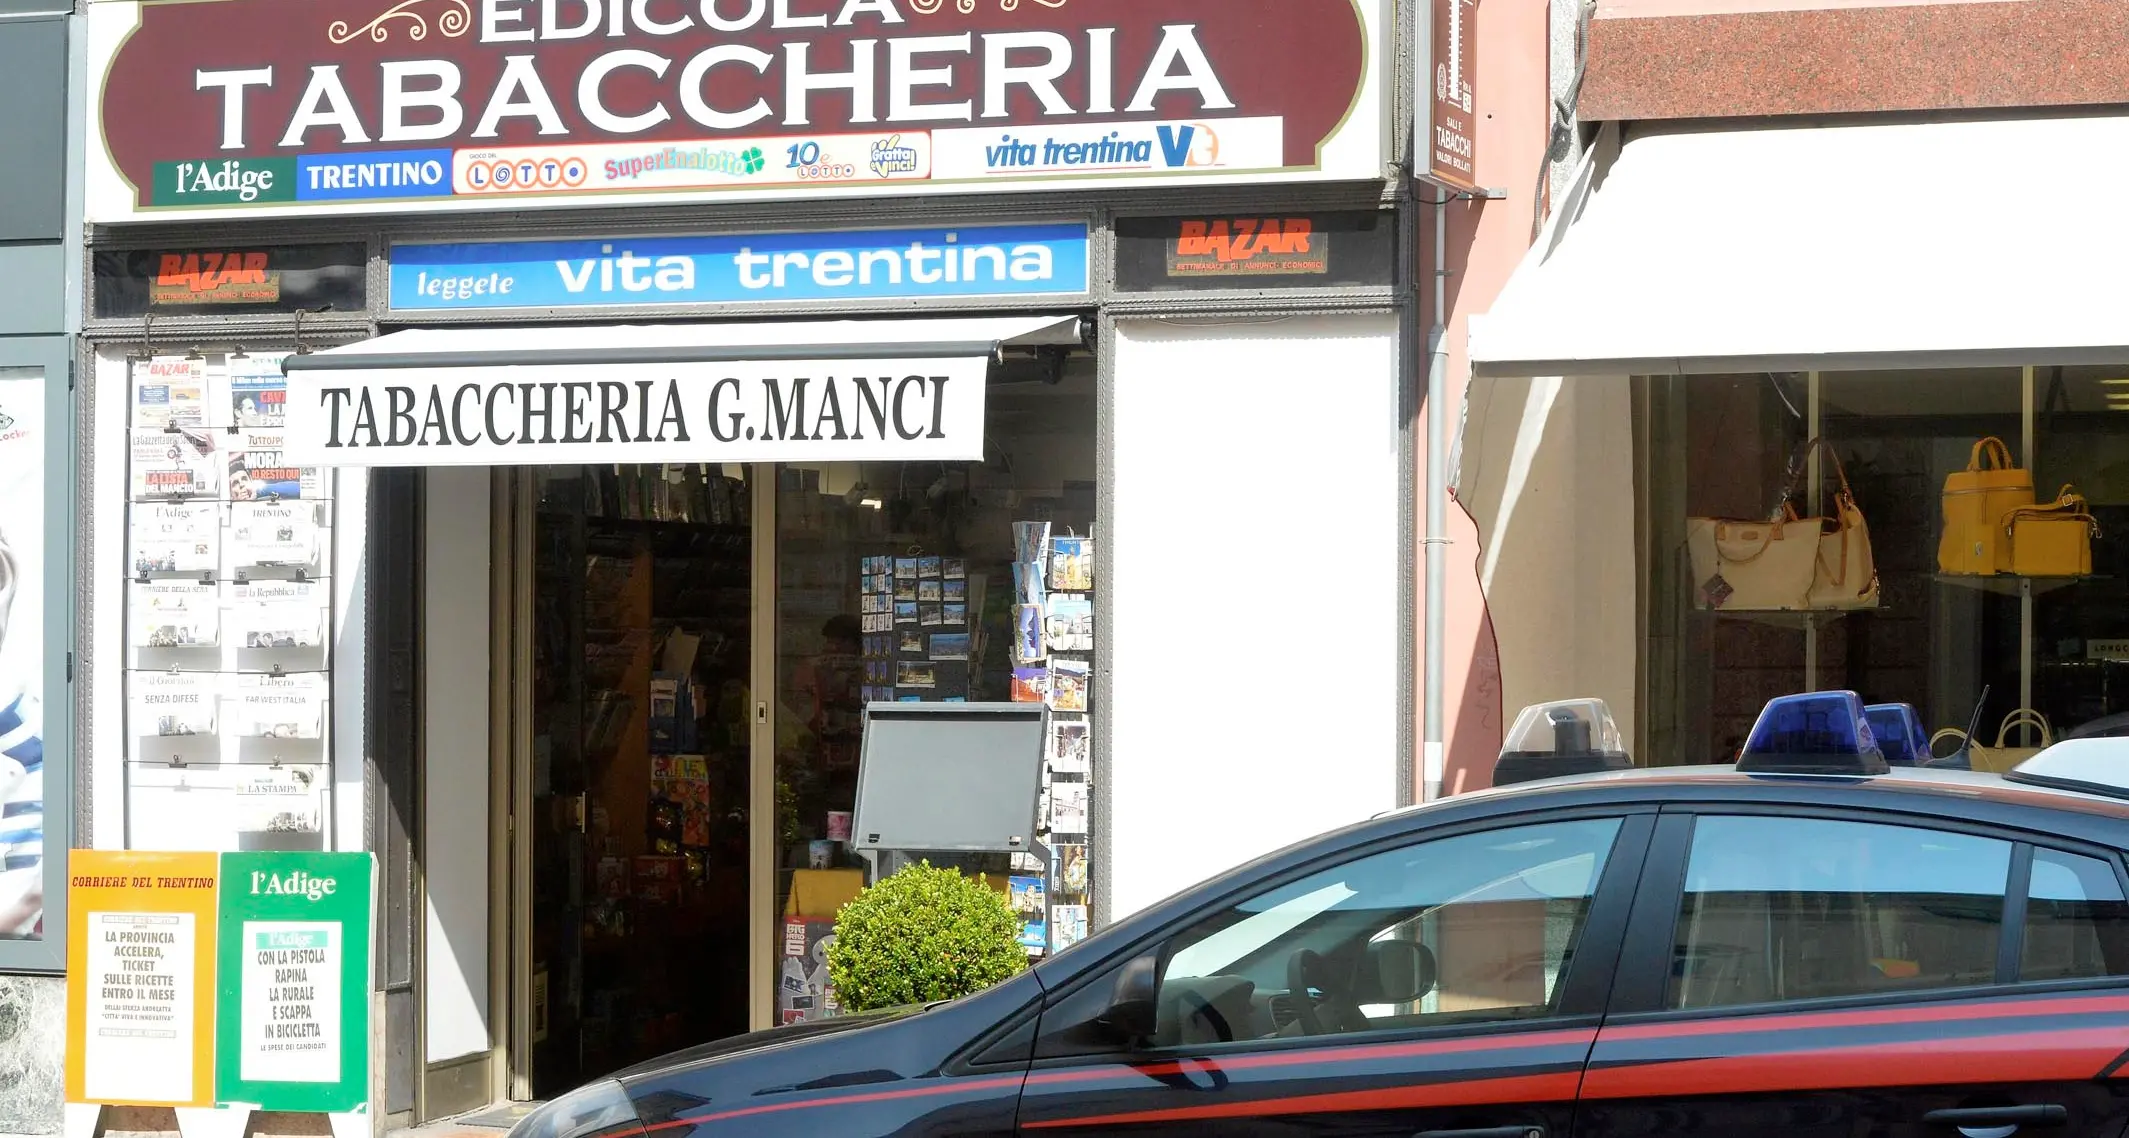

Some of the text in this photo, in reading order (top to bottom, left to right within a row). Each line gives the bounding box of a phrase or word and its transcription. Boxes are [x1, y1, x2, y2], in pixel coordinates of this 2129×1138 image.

[480, 0, 905, 42] EDICOLA
[196, 24, 1236, 149] TABACCHERIA
[985, 131, 1153, 167] vita trentina
[1436, 126, 1471, 158] TABACCHI
[604, 147, 746, 180] SuperEnalotto
[1436, 150, 1471, 174] VALORI BOLLATI
[175, 163, 273, 201] l'Adige
[306, 160, 443, 190] TRENTINO
[1177, 218, 1312, 263] BAZAR
[157, 252, 268, 292] BAZAR
[417, 233, 1053, 300] leggete vita trentina
[150, 363, 189, 377] BAZAR
[320, 375, 950, 449] TABACCHERIA G.MANCI
[160, 472, 188, 484] LISTA
[260, 469, 285, 480] RESTO
[285, 468, 299, 480] QUI
[257, 586, 295, 598] Repubblica
[259, 676, 294, 687] Libero
[145, 694, 199, 704] SENZA DIFESE
[245, 696, 306, 704] FAR WEST ITALIA
[260, 785, 297, 793] STAMPA
[72, 876, 214, 888] CORRIERE DEL TRENTINO
[250, 870, 337, 901] l'Adige
[105, 931, 175, 944] LA PROVINCIA
[114, 945, 164, 959] ACCELERA,
[258, 949, 326, 965] CON LA PISTOLA
[122, 960, 155, 971] TICKET
[104, 973, 174, 986] SULLE RICETTE
[275, 968, 308, 983] RAPINA
[102, 987, 175, 1001] ENTRO IL MESE
[269, 986, 314, 1002] LA RURALE
[272, 1004, 312, 1020] E SCAPPA
[265, 1022, 321, 1039] IN BICICLETTA
